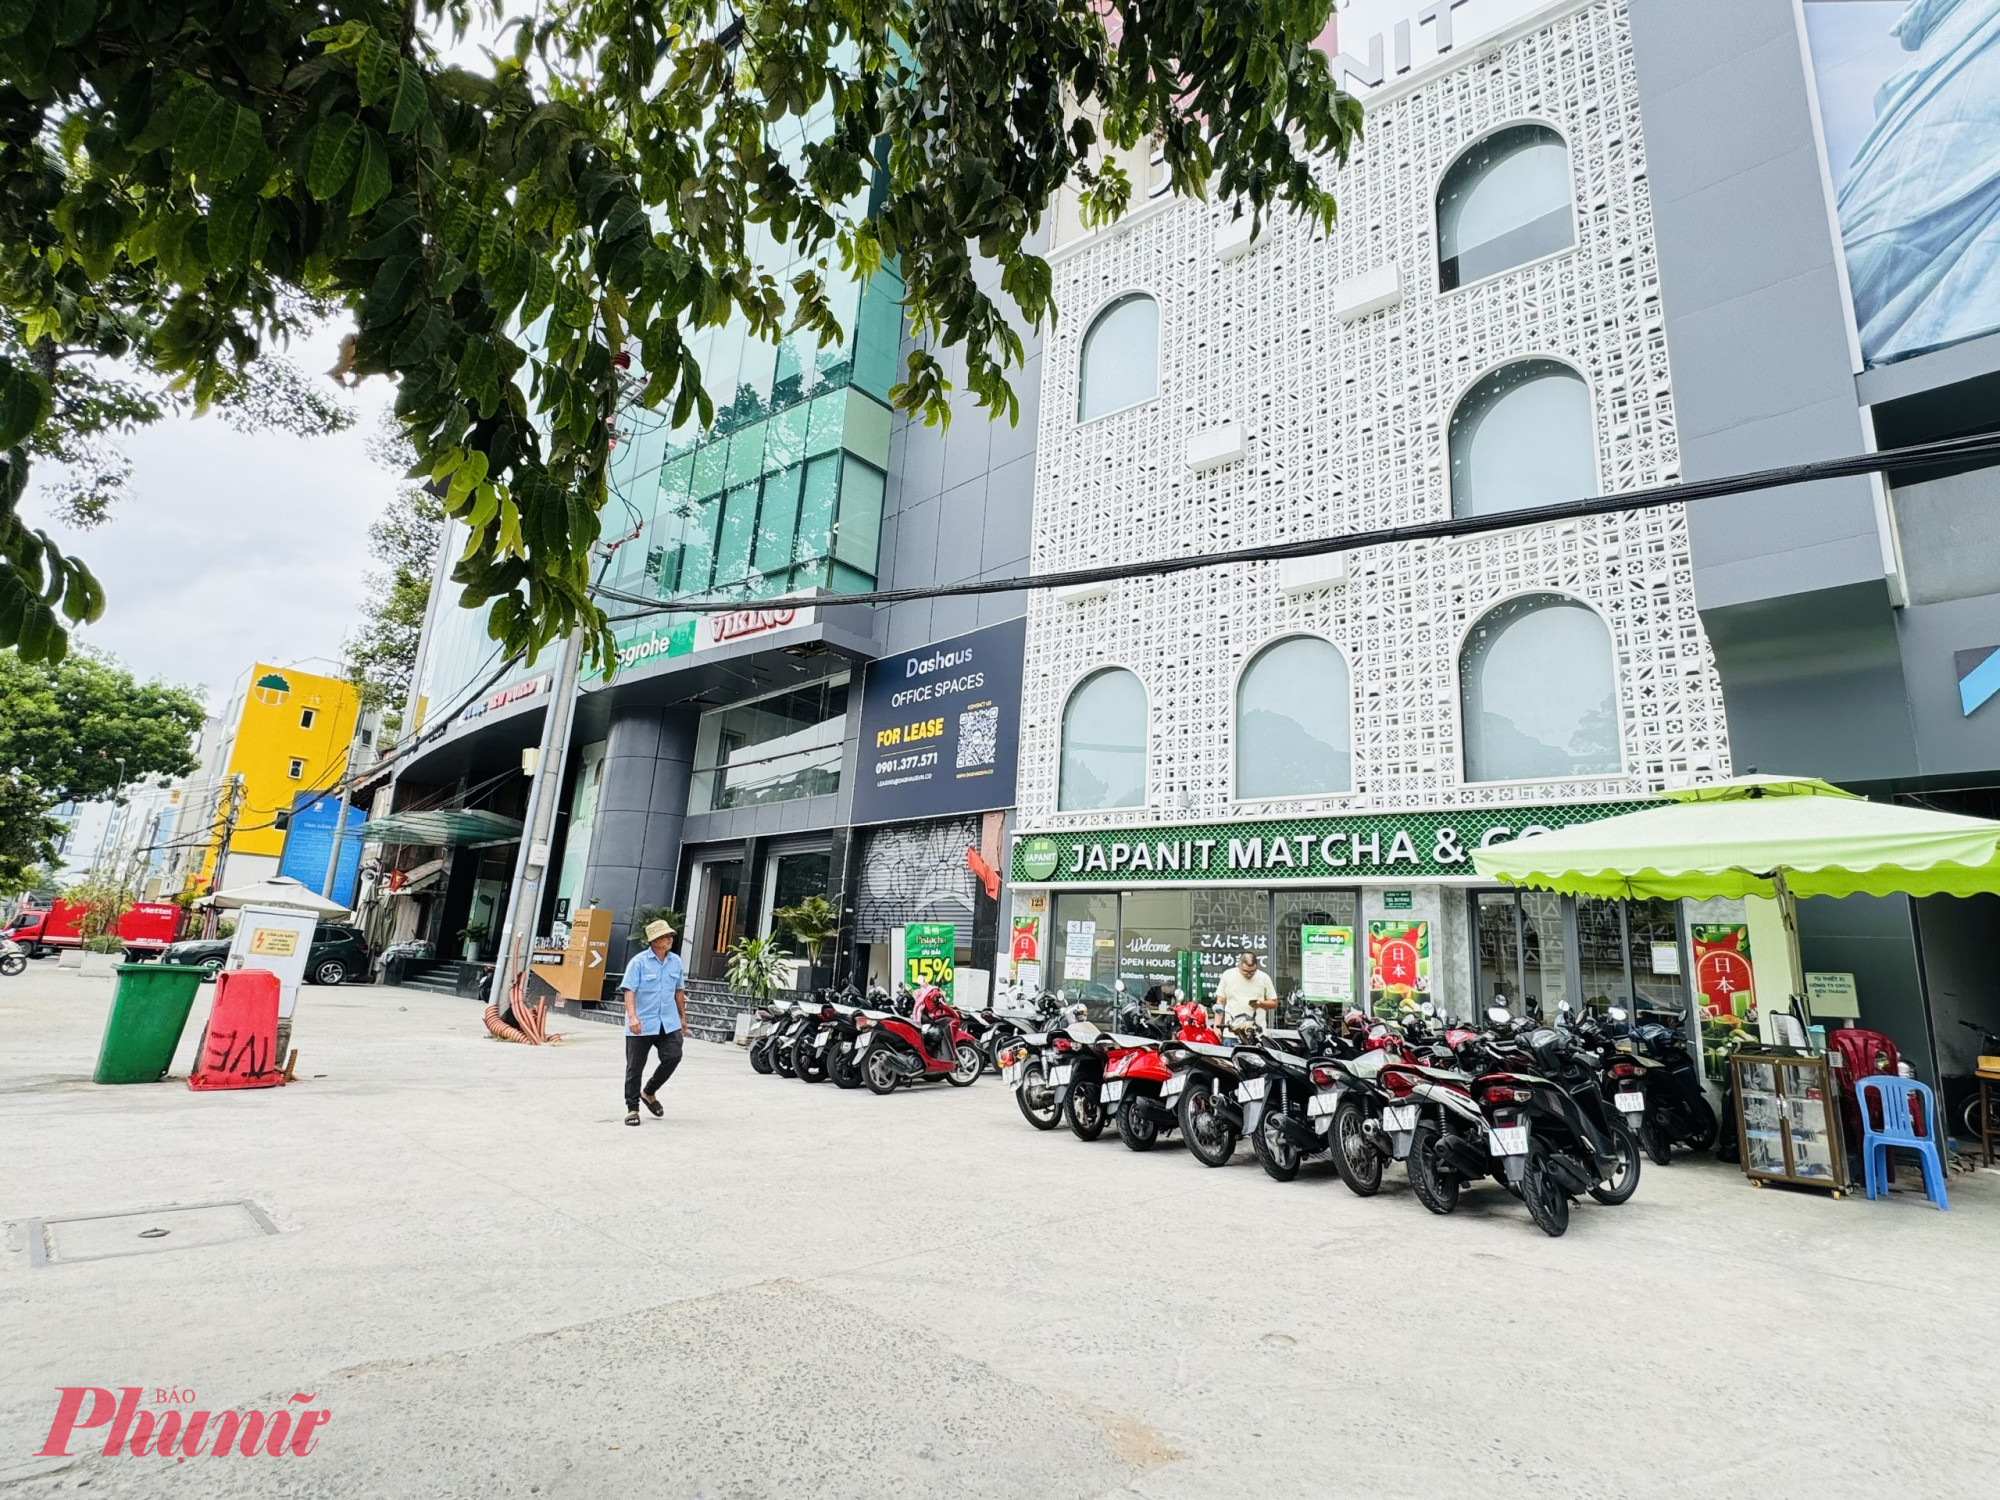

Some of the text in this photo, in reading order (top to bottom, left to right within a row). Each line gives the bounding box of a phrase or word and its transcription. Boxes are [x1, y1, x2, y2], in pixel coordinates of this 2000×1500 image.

[906, 648, 973, 678] Dashaus
[891, 672, 985, 708] OFFICE SPACES
[876, 717, 945, 748] FOR LEASE
[875, 752, 938, 774] 0901.377.571
[1025, 852, 1057, 862] JAPANIT
[1070, 838, 1216, 873] JAPANIT
[1229, 832, 1421, 870] MATCHA
[1432, 827, 1467, 864] &
[140, 906, 172, 915] viettel
[1031, 898, 1044, 907] 123
[1126, 937, 1171, 953] Welcome
[1200, 933, 1268, 949] こんにちは
[908, 958, 953, 984] 15%
[1120, 958, 1176, 968] OPEN HOURS
[1392, 947, 1406, 978] 日本
[1120, 972, 1144, 980] 9:00am
[1714, 957, 1735, 994] 日本
